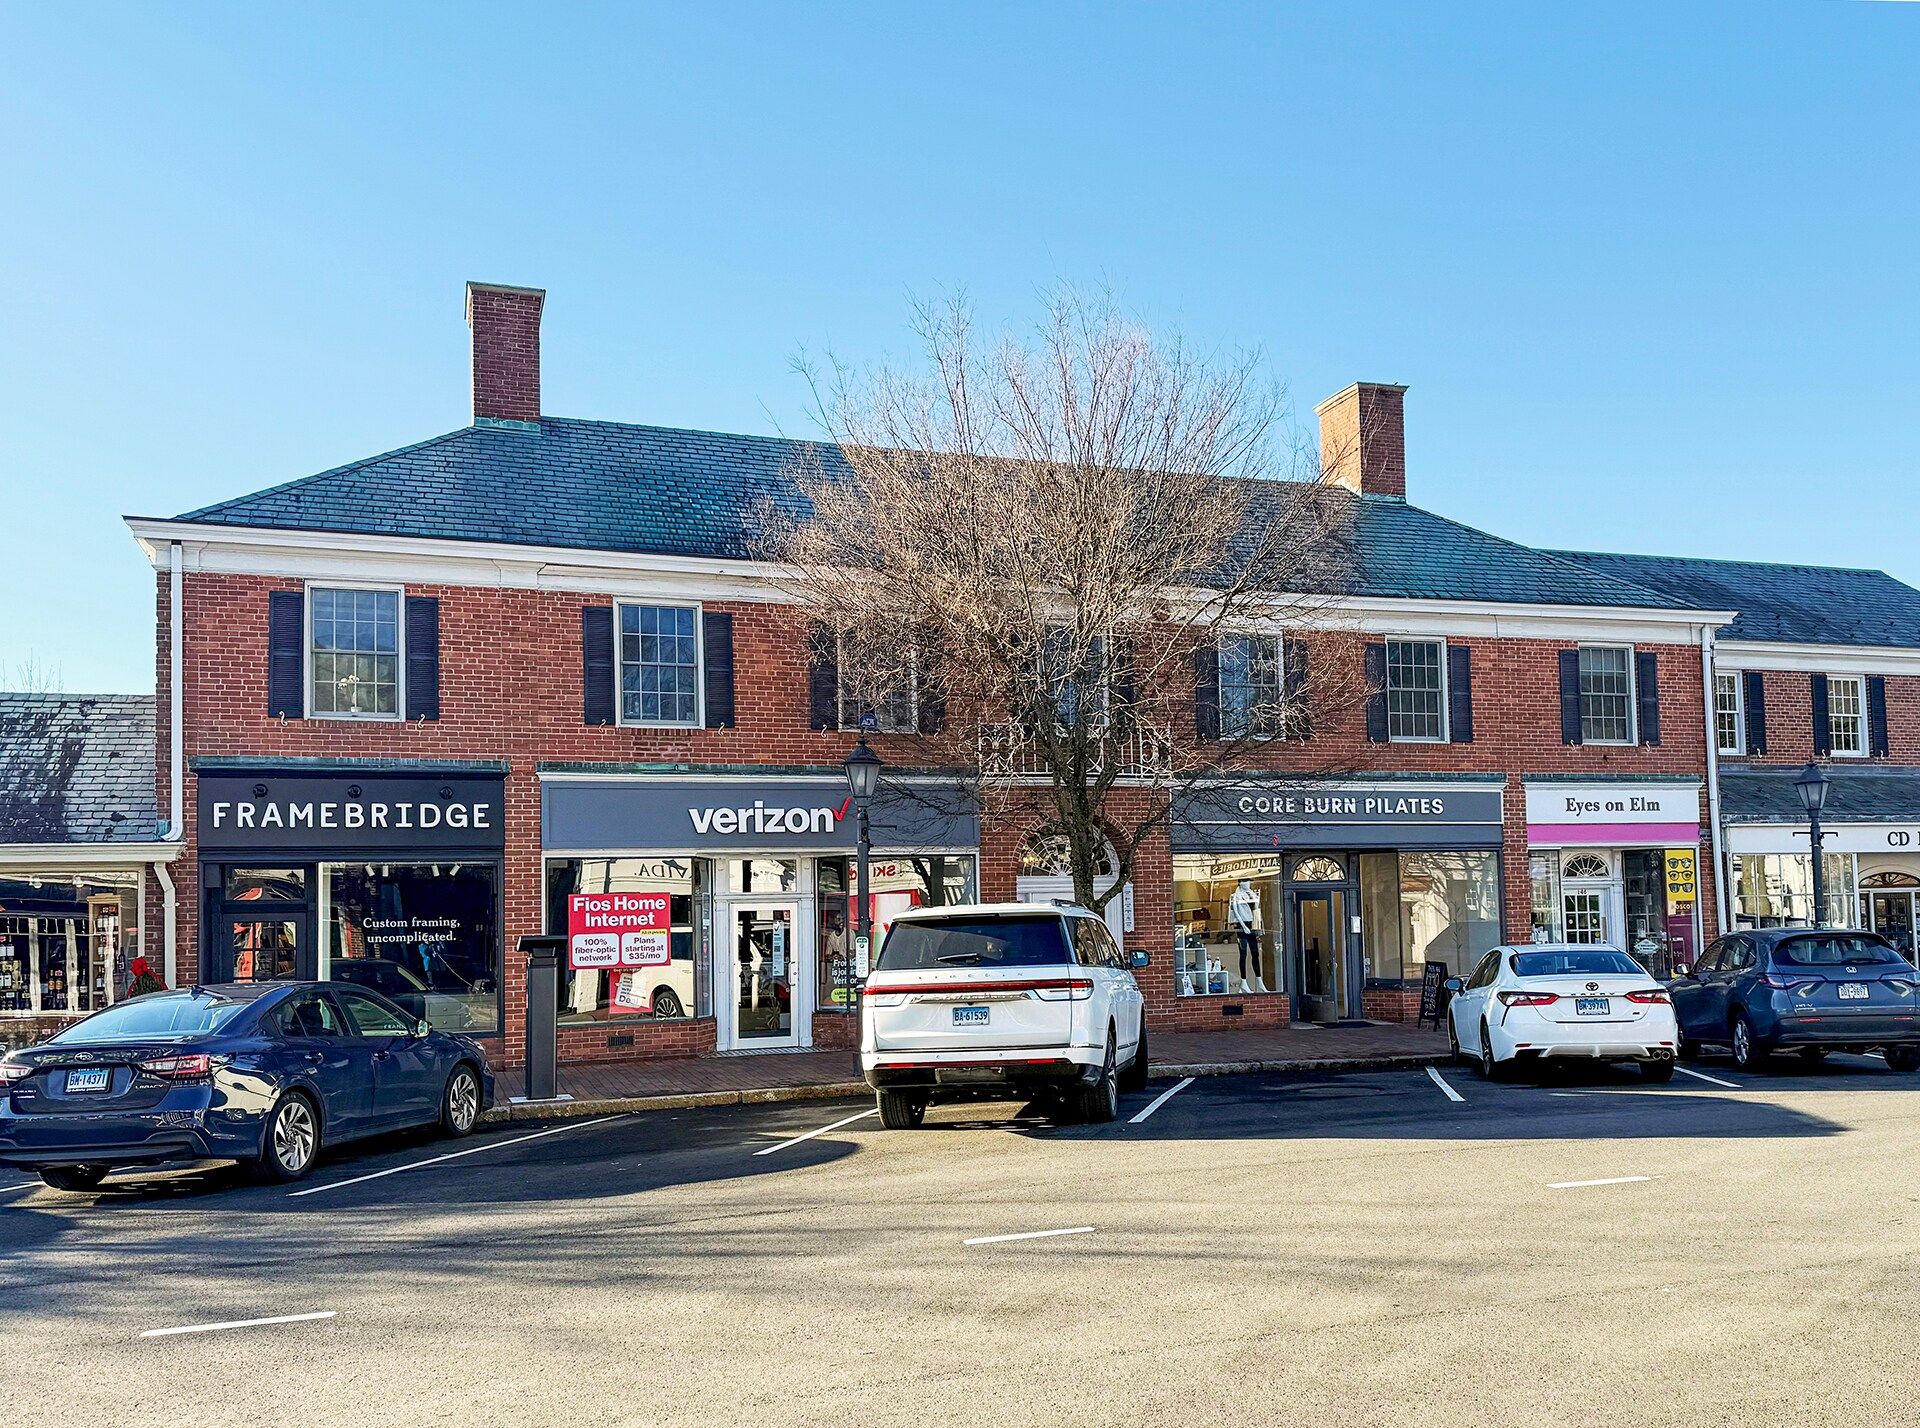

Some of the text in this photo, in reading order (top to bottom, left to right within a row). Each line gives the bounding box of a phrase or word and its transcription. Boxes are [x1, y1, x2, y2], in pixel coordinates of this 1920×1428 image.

[1238, 797, 1444, 814] CORE BURN PILATES
[1565, 797, 1660, 816] Eyes on Elm
[212, 802, 490, 828] FRAMEBRIDGE
[688, 800, 834, 834] verizon
[1887, 831, 1910, 846] CD
[573, 896, 666, 912] Fios Home
[363, 916, 461, 929] Custom framing,
[585, 912, 655, 927] Internet
[367, 930, 457, 944] uncomplicated.
[584, 938, 608, 946] 100%
[633, 937, 656, 945] Plans
[575, 945, 617, 955] fiber-optic
[625, 945, 655, 953] starting
[628, 952, 661, 960] $35/mo
[579, 954, 612, 962] network
